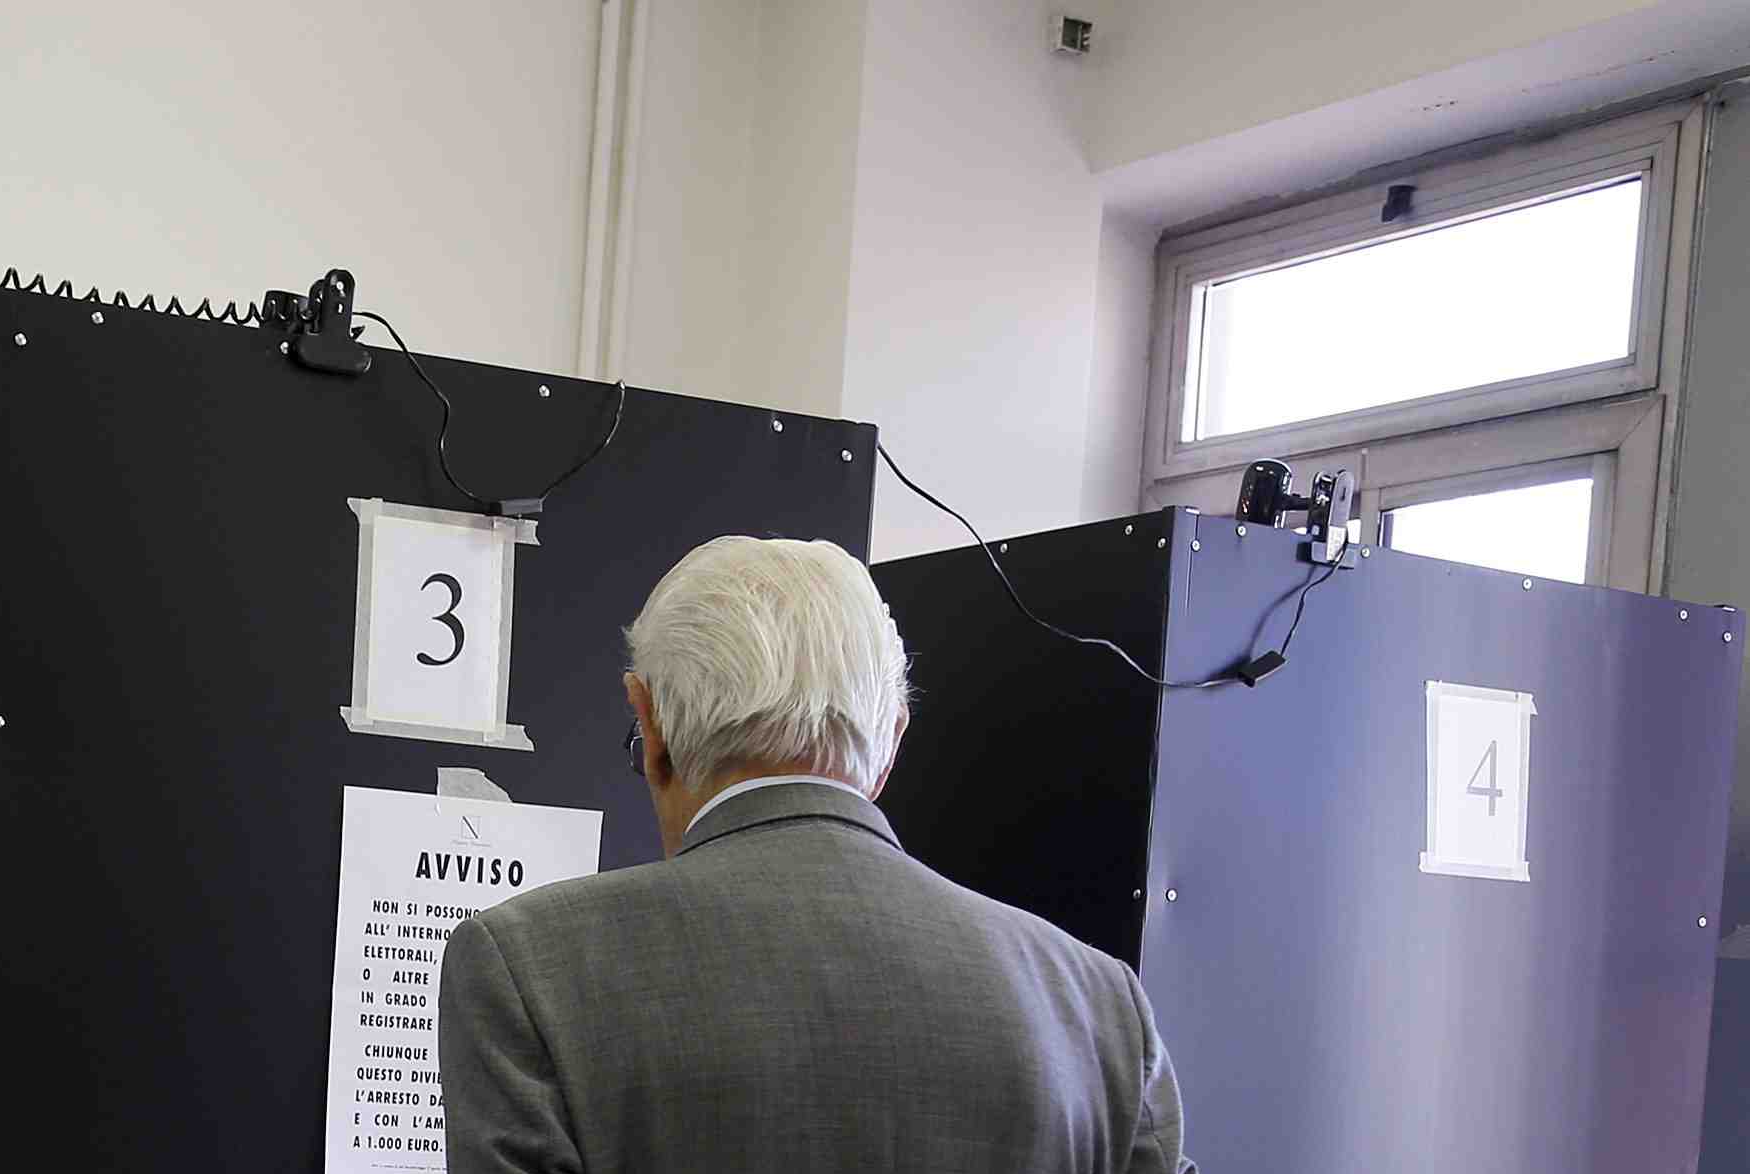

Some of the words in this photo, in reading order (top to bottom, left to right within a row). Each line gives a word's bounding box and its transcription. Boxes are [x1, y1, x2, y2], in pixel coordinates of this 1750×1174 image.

[416, 573, 465, 666] 3
[1466, 740, 1503, 816] 4
[415, 851, 525, 888] AVVISO
[373, 900, 399, 914] NON
[407, 903, 418, 915] SI
[365, 922, 390, 936] ALL'
[397, 925, 451, 941] INTERNO
[364, 945, 438, 965] ELETTORALI,
[363, 968, 371, 980] O
[392, 971, 430, 985] ALTRE
[361, 990, 375, 1005] IN
[385, 992, 427, 1008] GRADO
[360, 1014, 433, 1031] REGISTRARE
[365, 1045, 428, 1060] CHIUNQUE
[357, 1067, 402, 1081] QUESTO
[411, 1071, 442, 1084] DIVIE
[355, 1089, 419, 1105] L'ARRESTO
[355, 1113, 360, 1125] E
[374, 1114, 399, 1127] CON
[353, 1136, 360, 1148] A
[368, 1136, 402, 1150] 1.000
[407, 1138, 443, 1152] EURO.
